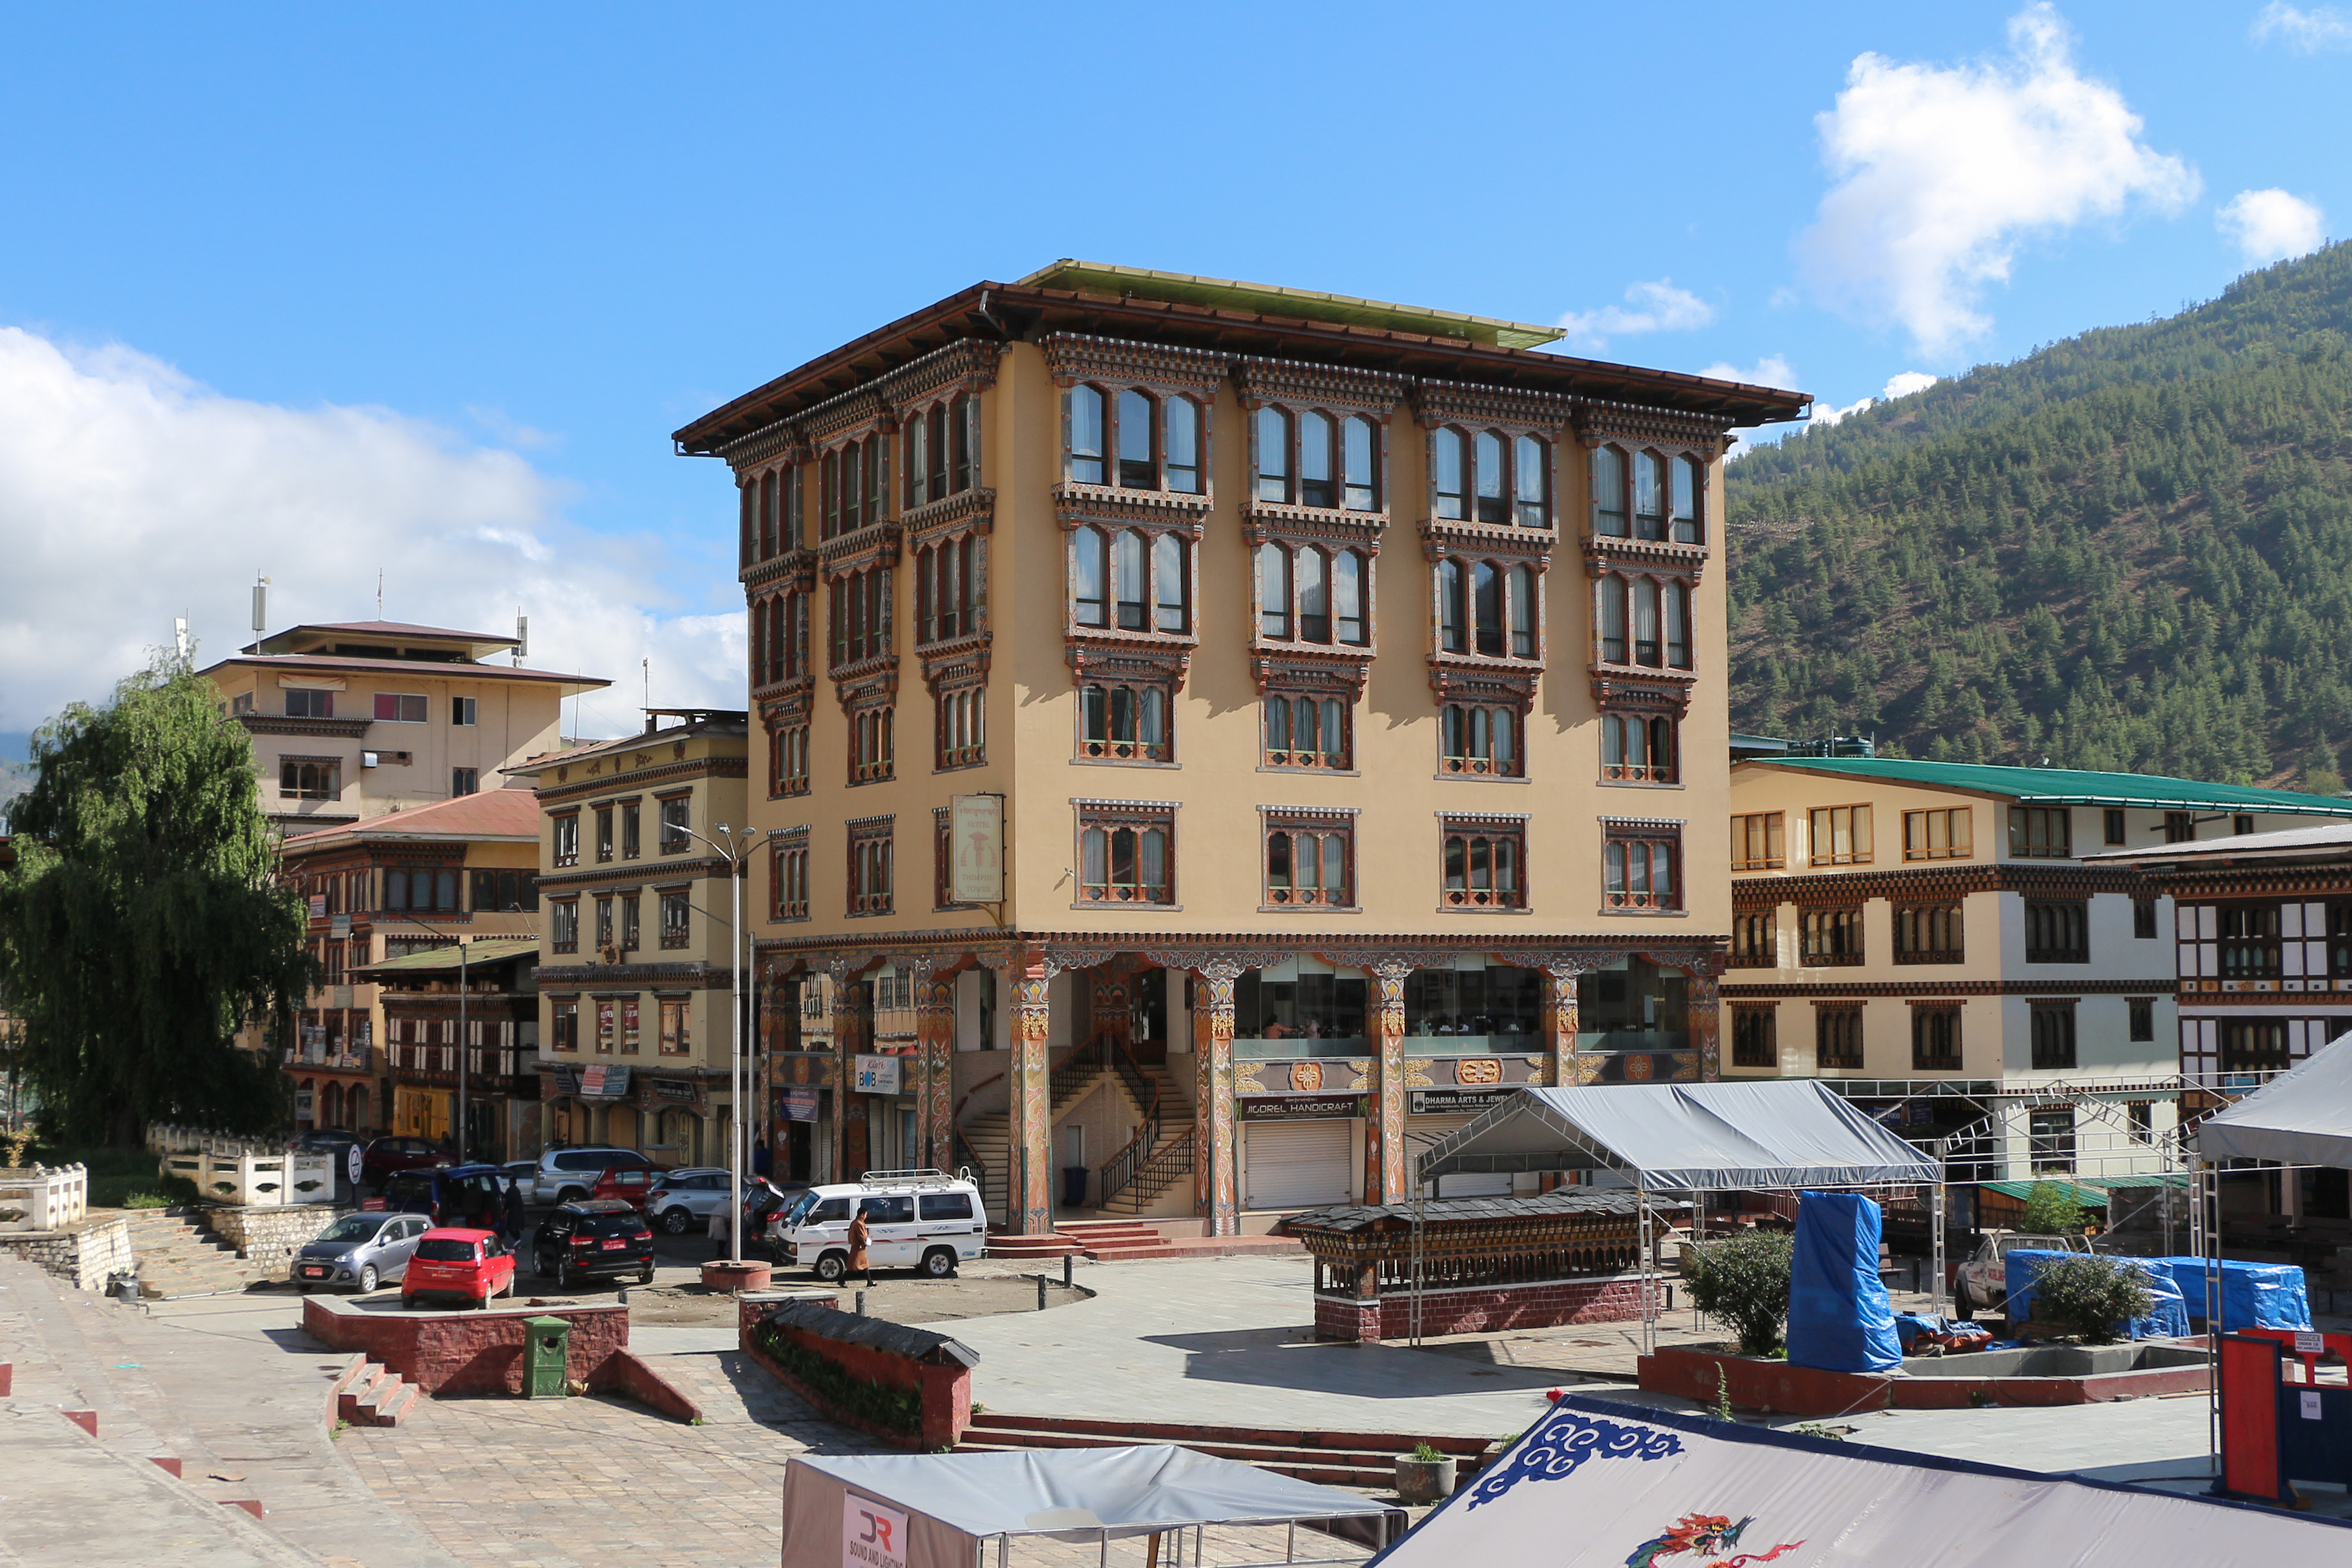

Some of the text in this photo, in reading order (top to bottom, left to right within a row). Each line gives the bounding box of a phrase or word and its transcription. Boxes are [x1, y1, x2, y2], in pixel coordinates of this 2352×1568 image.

[1247, 1102, 1353, 1113] JIGDREL HANDICRAFT
[1934, 1100, 1951, 1109] AST
[850, 1541, 867, 1561] SOUND
[868, 1549, 879, 1566] AND
